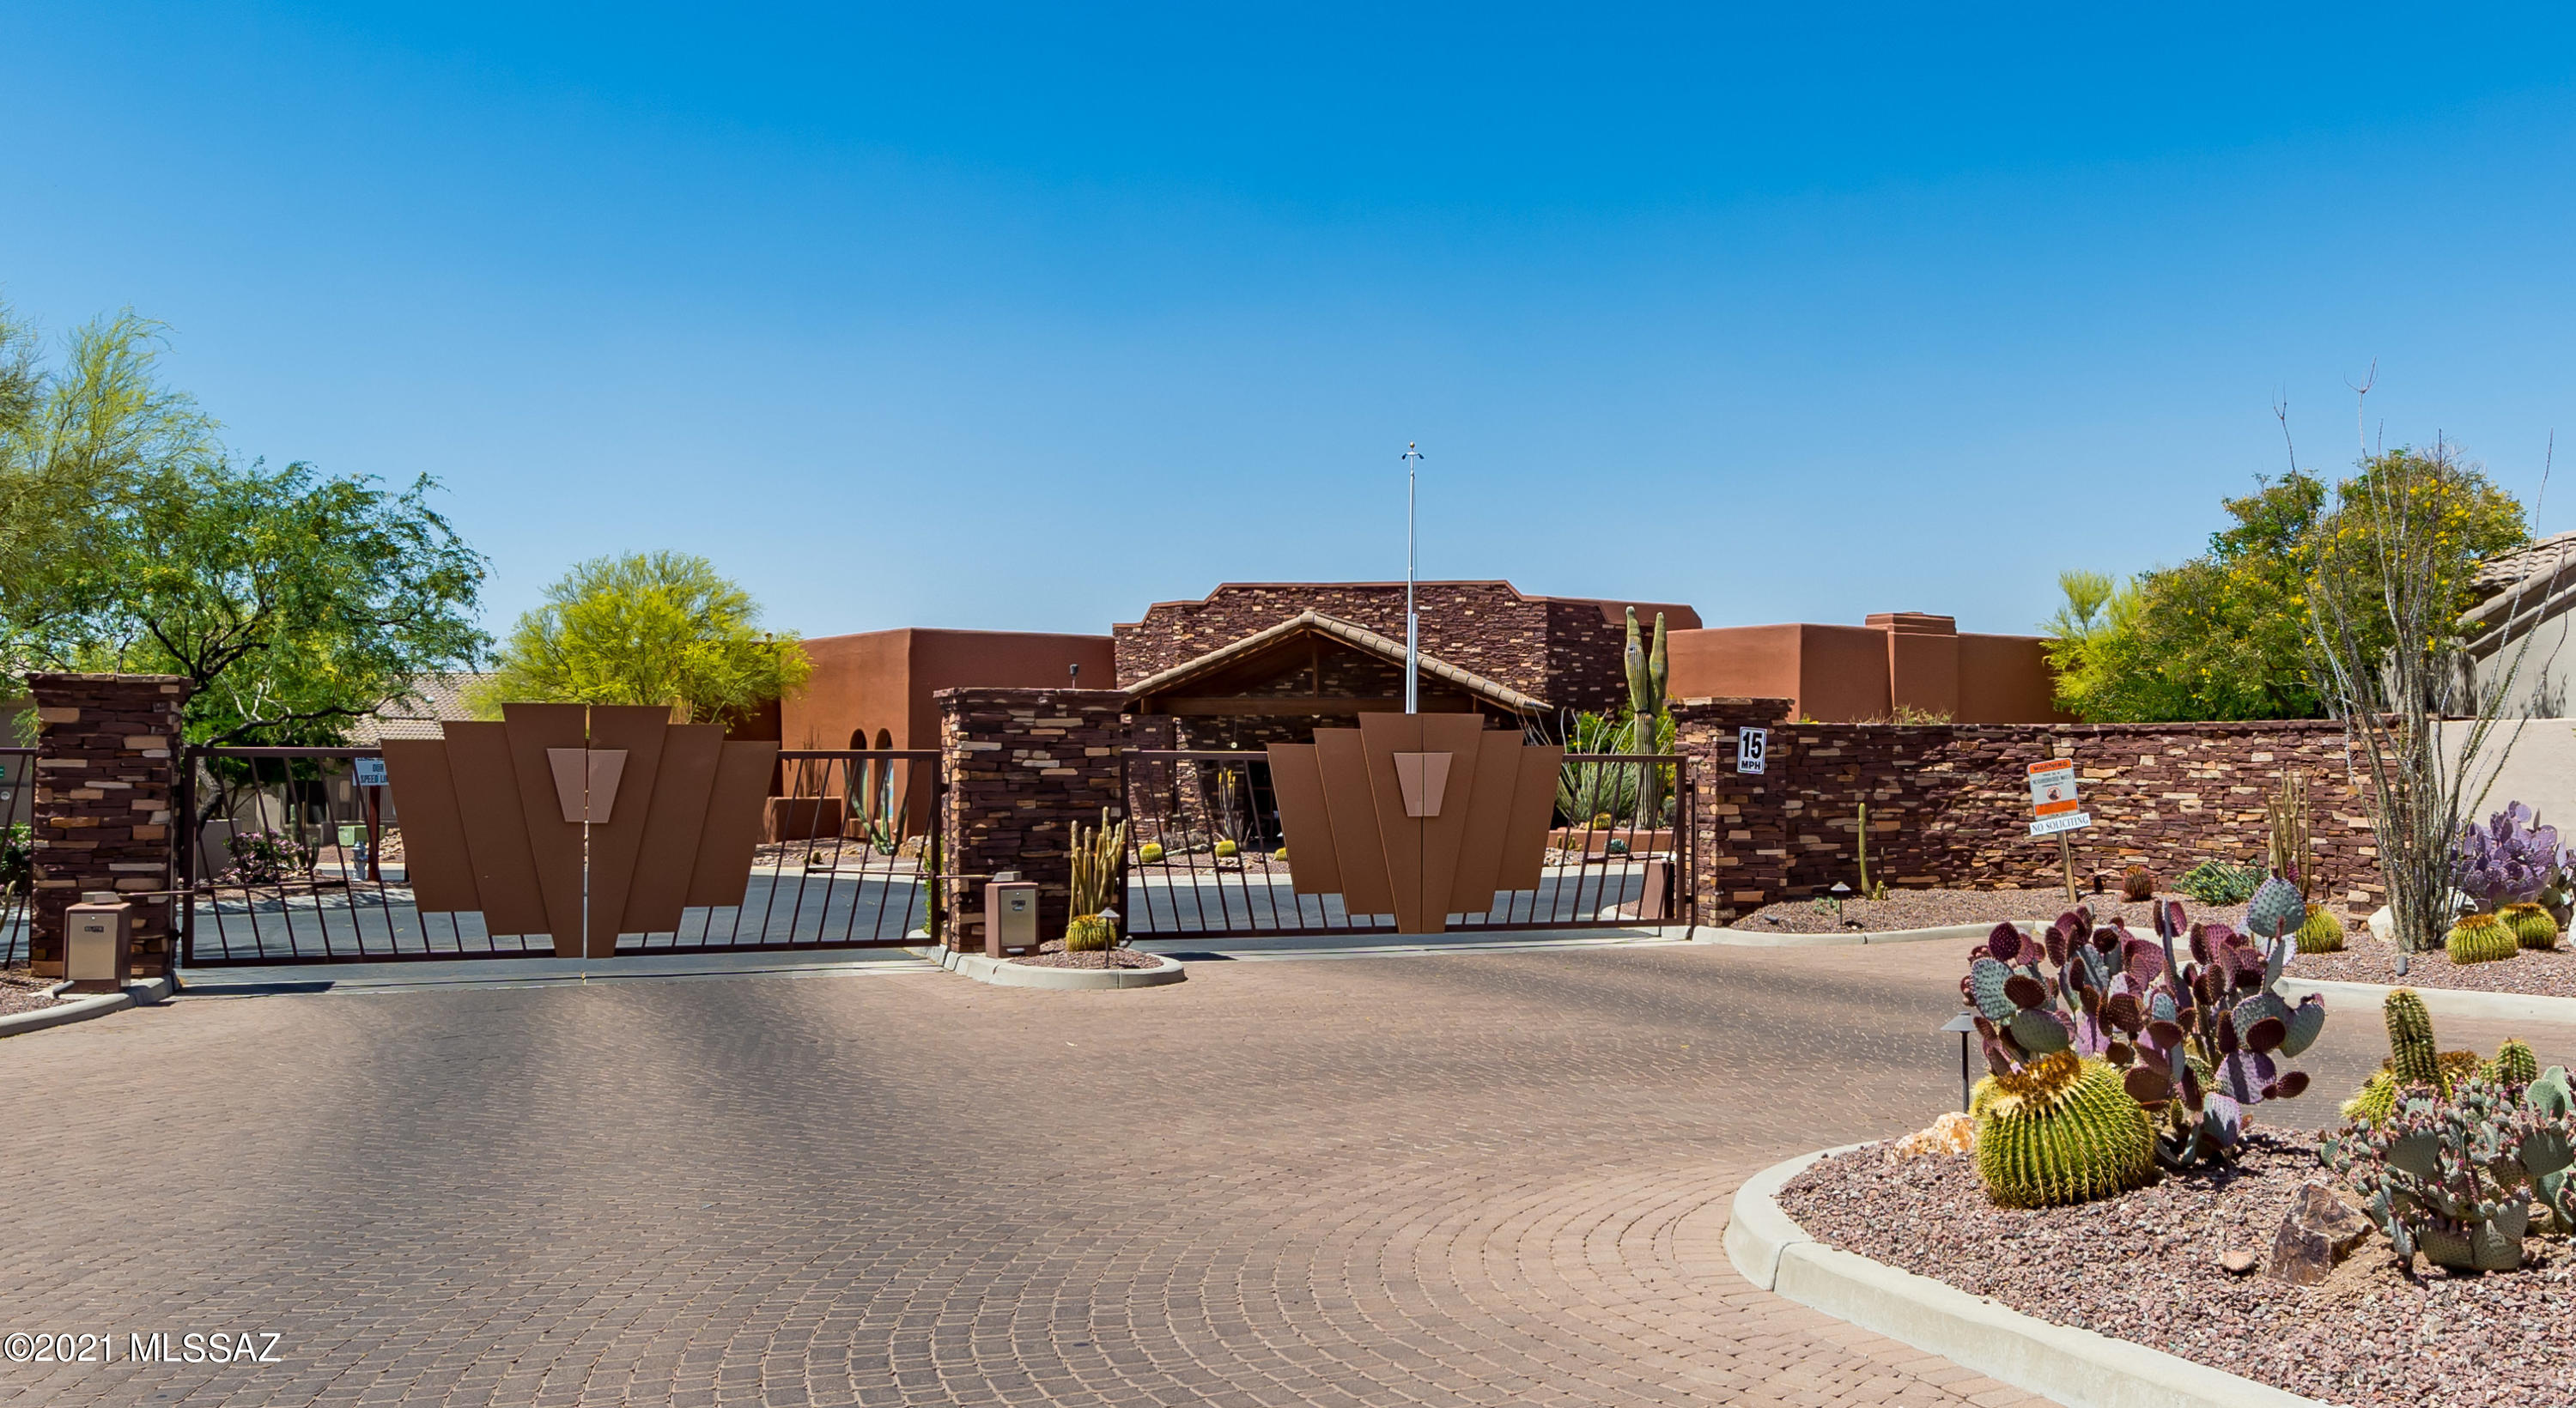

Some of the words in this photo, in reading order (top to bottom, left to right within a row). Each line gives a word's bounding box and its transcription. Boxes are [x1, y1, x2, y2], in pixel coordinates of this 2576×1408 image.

[1743, 731, 1762, 759] 15
[1741, 761, 1760, 770] MPH
[2032, 822, 2044, 832] NO
[2045, 816, 2089, 829] SOLICITING
